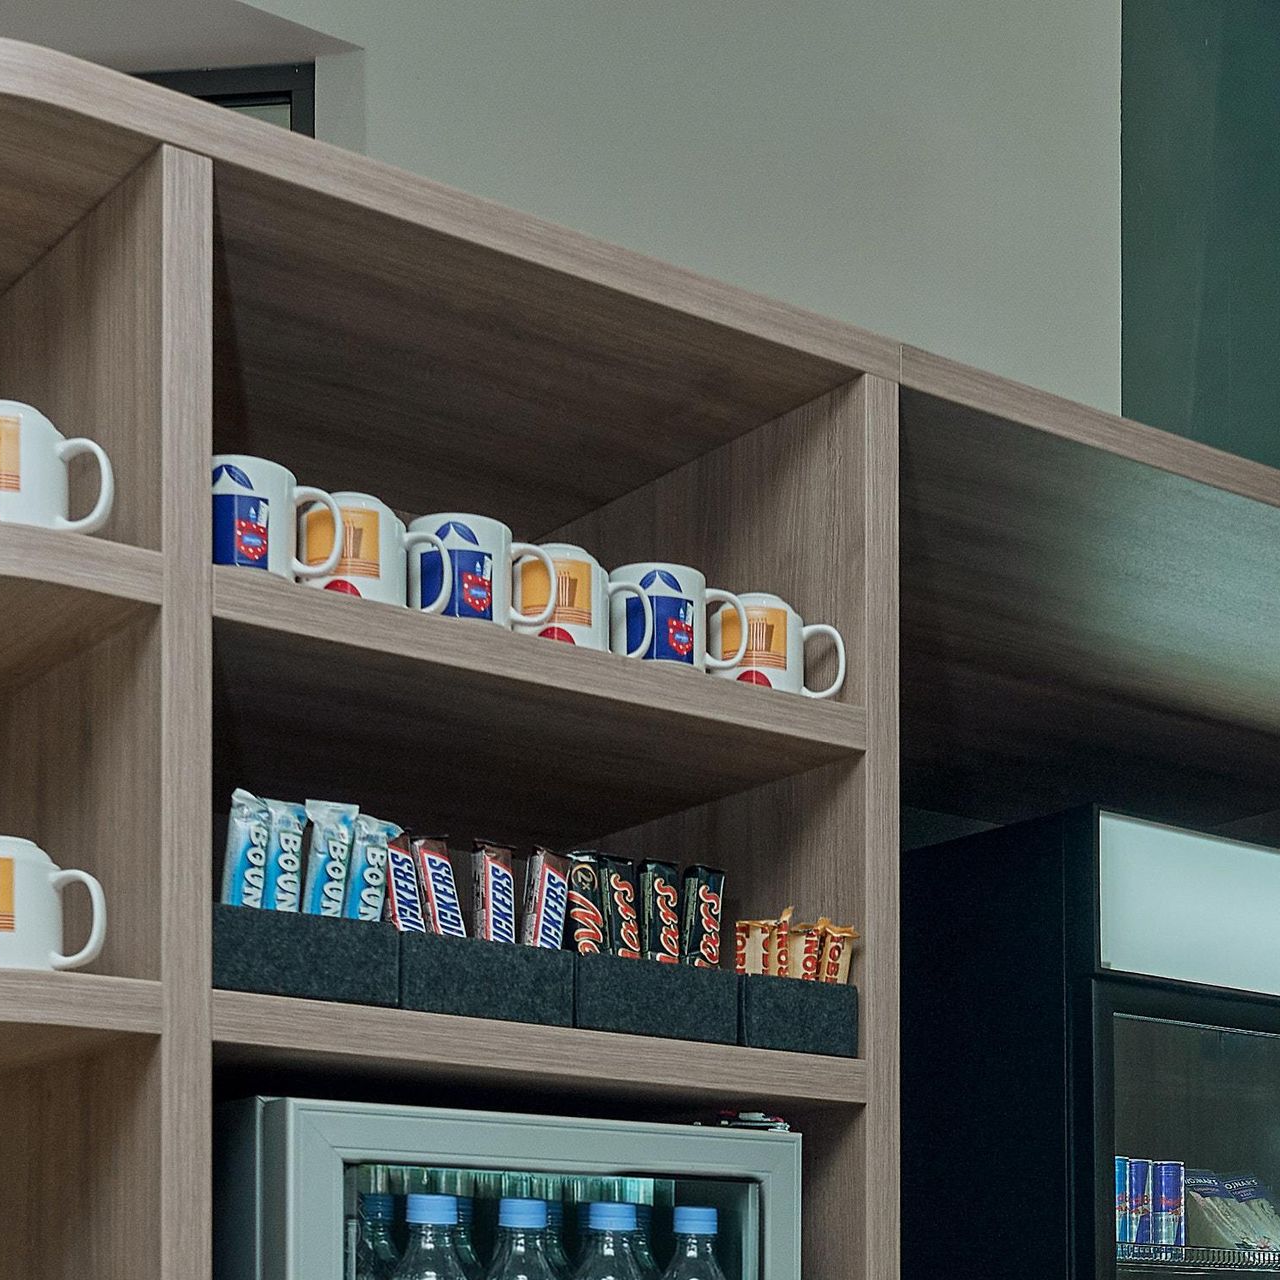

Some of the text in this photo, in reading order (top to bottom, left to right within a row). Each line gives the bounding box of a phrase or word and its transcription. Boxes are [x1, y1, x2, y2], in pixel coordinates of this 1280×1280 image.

[241, 825, 269, 908] BOUN
[276, 832, 302, 912] BOUN
[320, 840, 348, 918] BOUN
[359, 846, 387, 921] BOUN
[391, 852, 424, 932] ICKERS
[427, 857, 464, 937] ICKERS
[490, 865, 515, 943] ICKERS
[540, 874, 567, 949] ICKERS
